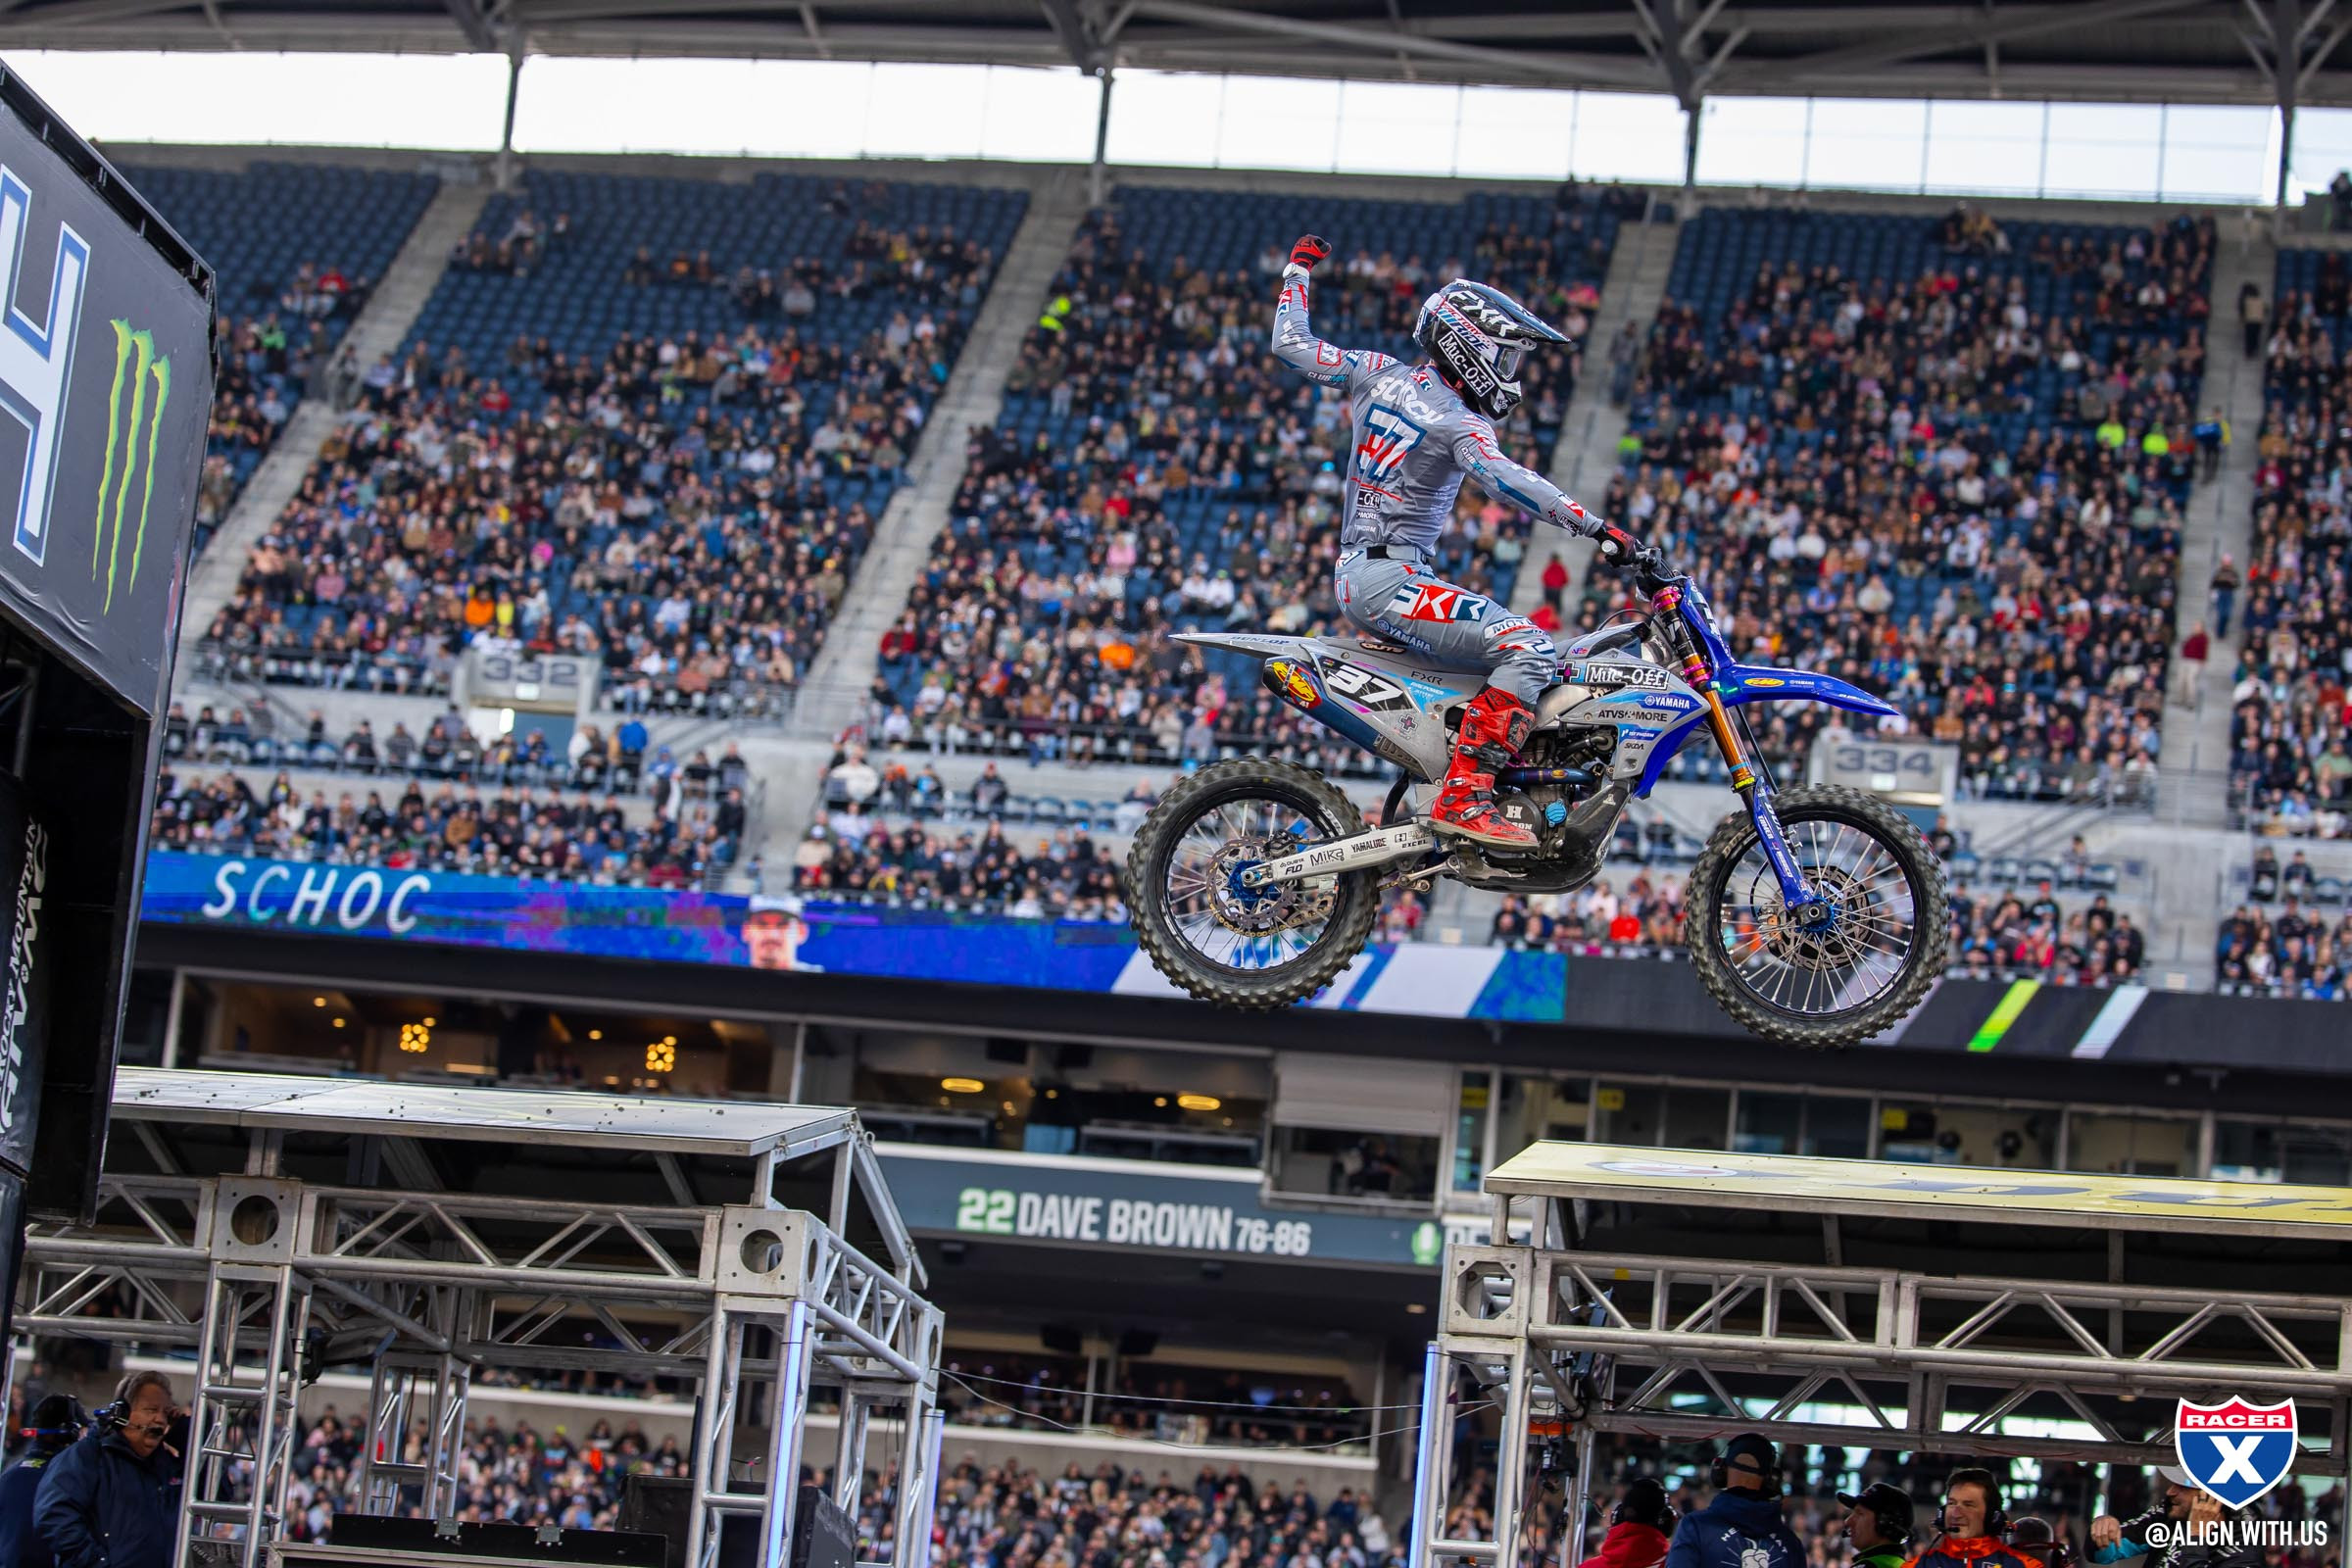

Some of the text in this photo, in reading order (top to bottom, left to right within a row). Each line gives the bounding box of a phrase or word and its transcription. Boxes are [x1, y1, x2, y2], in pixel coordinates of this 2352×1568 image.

[1443, 300, 1482, 336] FACTORY
[1447, 290, 1520, 337] FXR
[1453, 318, 1491, 352] RIDE
[1442, 335, 1493, 394] Muc-Off
[1388, 583, 1489, 622] FXR
[1231, 635, 1290, 645] DUNLOP
[1389, 626, 1432, 653] YAMAHA
[483, 656, 579, 686] 332
[1326, 664, 1403, 704] 37
[1411, 671, 1443, 685] FXR
[1654, 696, 1690, 710] YAMAHA
[1836, 747, 1934, 776] 334
[1506, 806, 1523, 819] H
[1351, 838, 1387, 853] YAMALUBE
[202, 860, 432, 933] SCHOC
[957, 1188, 1312, 1256] 22 DAVE BROWN 76-86
